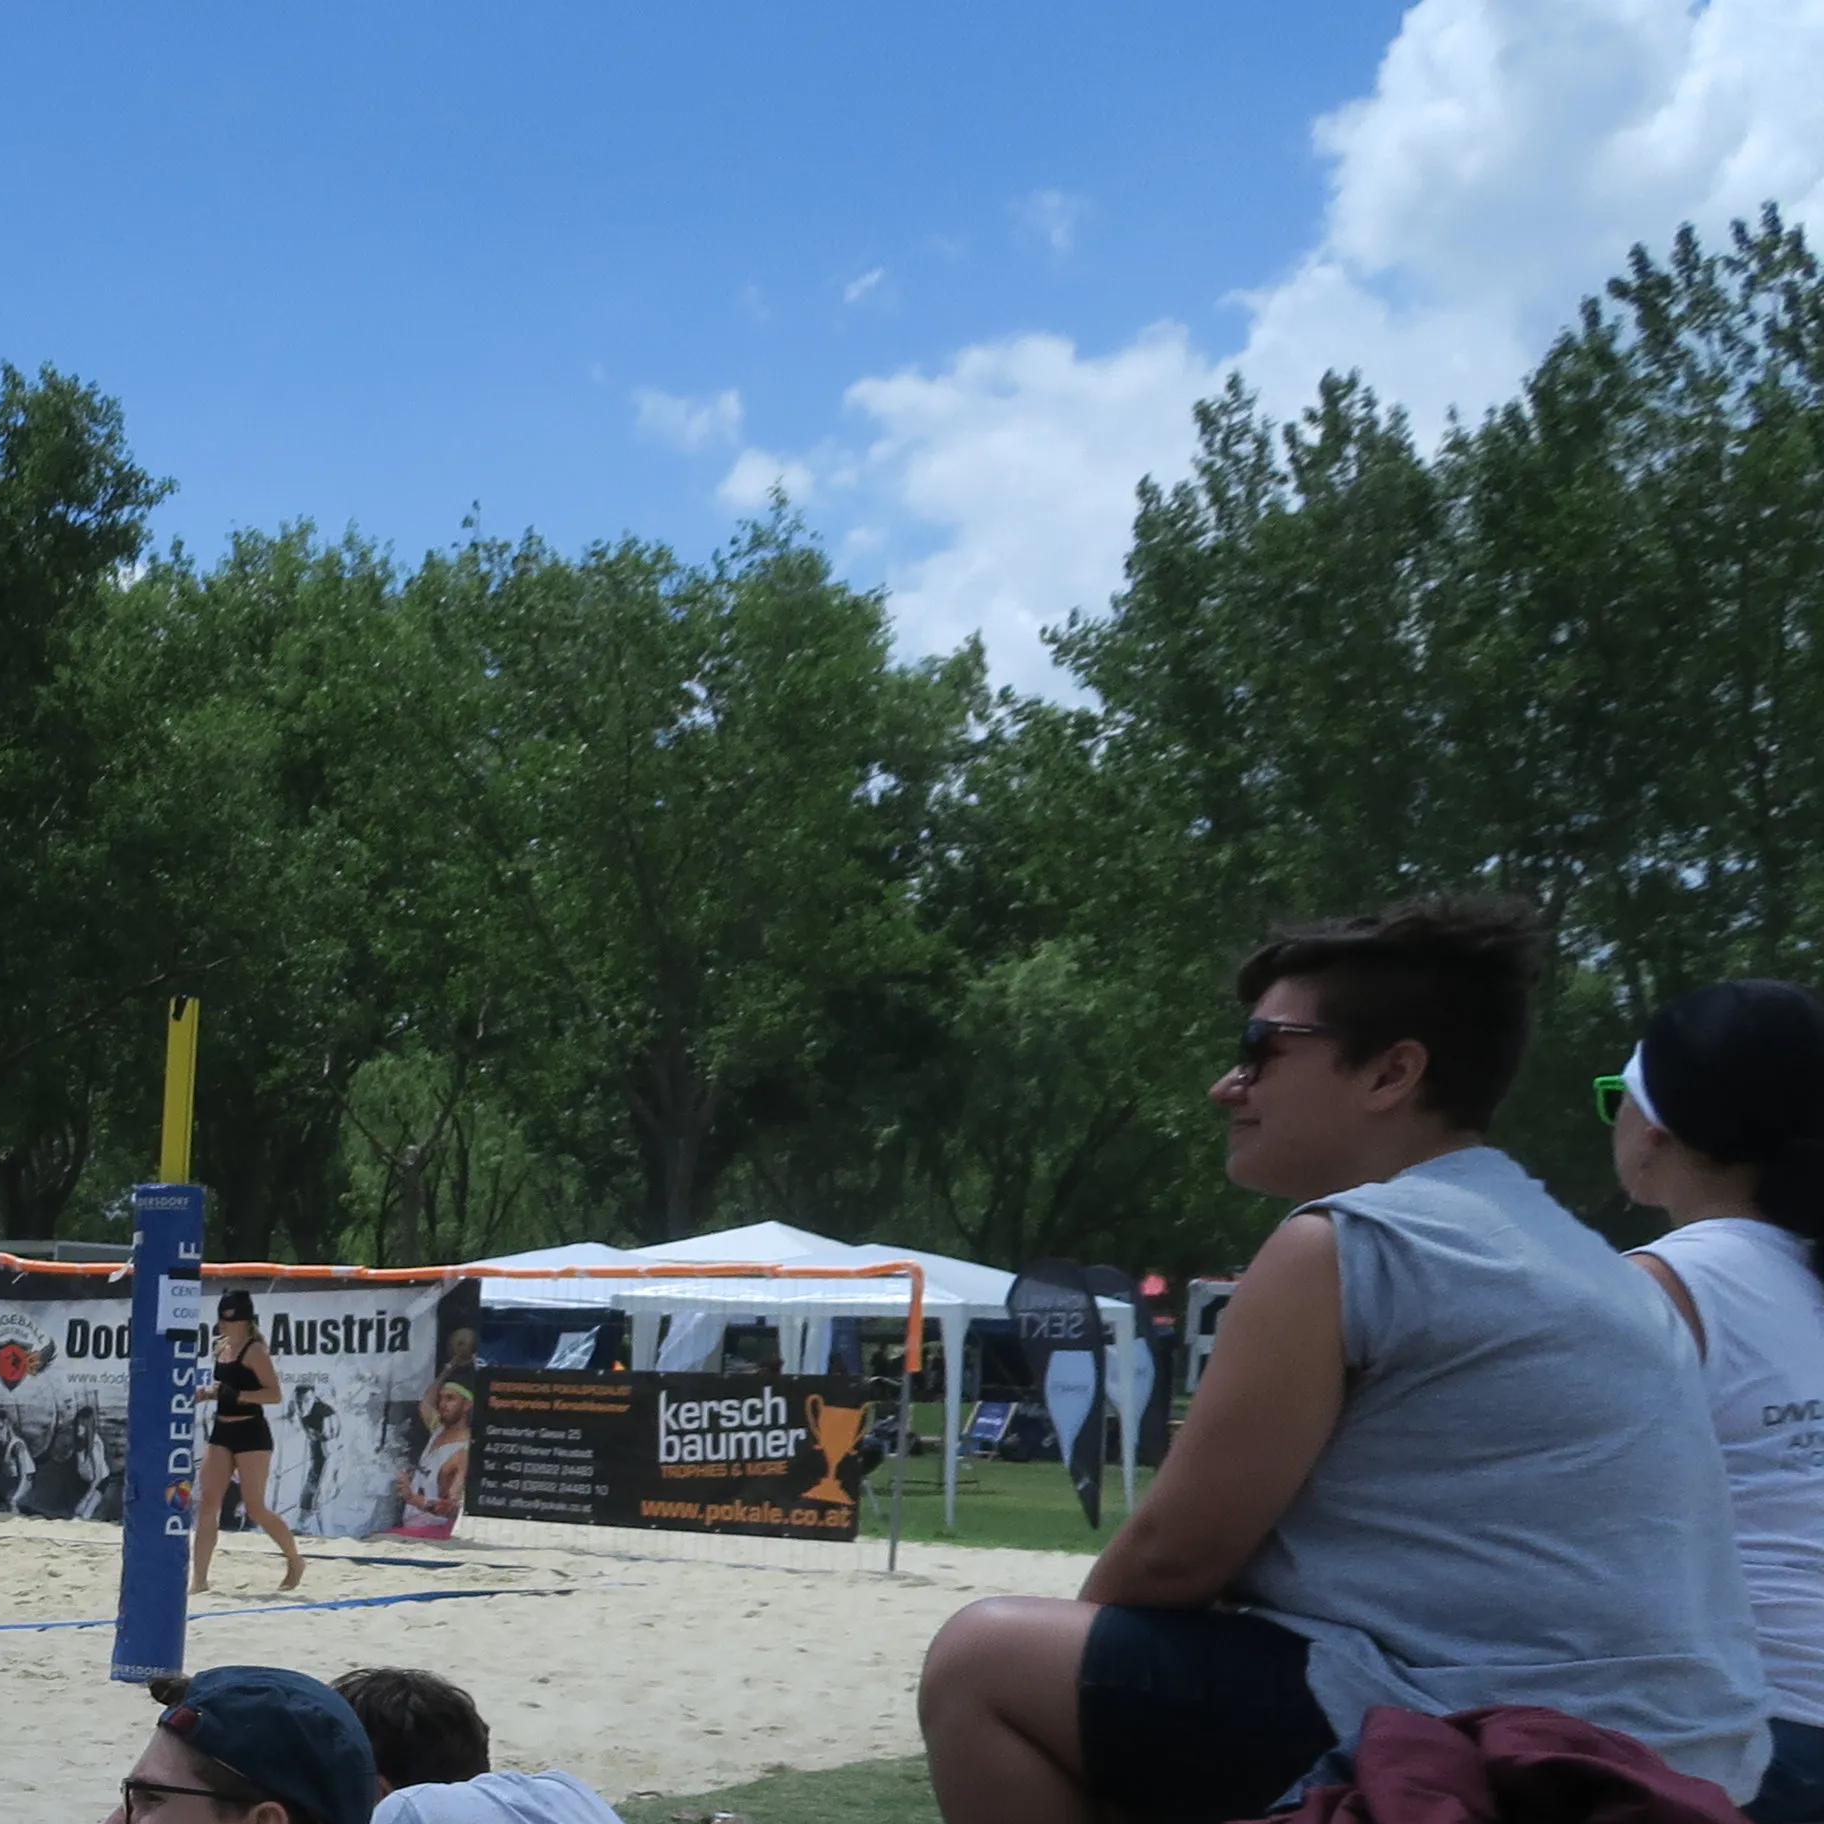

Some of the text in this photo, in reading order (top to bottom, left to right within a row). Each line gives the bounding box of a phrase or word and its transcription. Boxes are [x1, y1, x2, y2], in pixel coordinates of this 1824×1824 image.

[270, 1309, 412, 1356] Austria
[658, 1385, 787, 1431] kersch
[658, 1426, 807, 1464] baumer
[660, 1463, 729, 1479] TROPHIES
[746, 1460, 790, 1476] MORE
[639, 1497, 854, 1529] www.pokale.co.at
